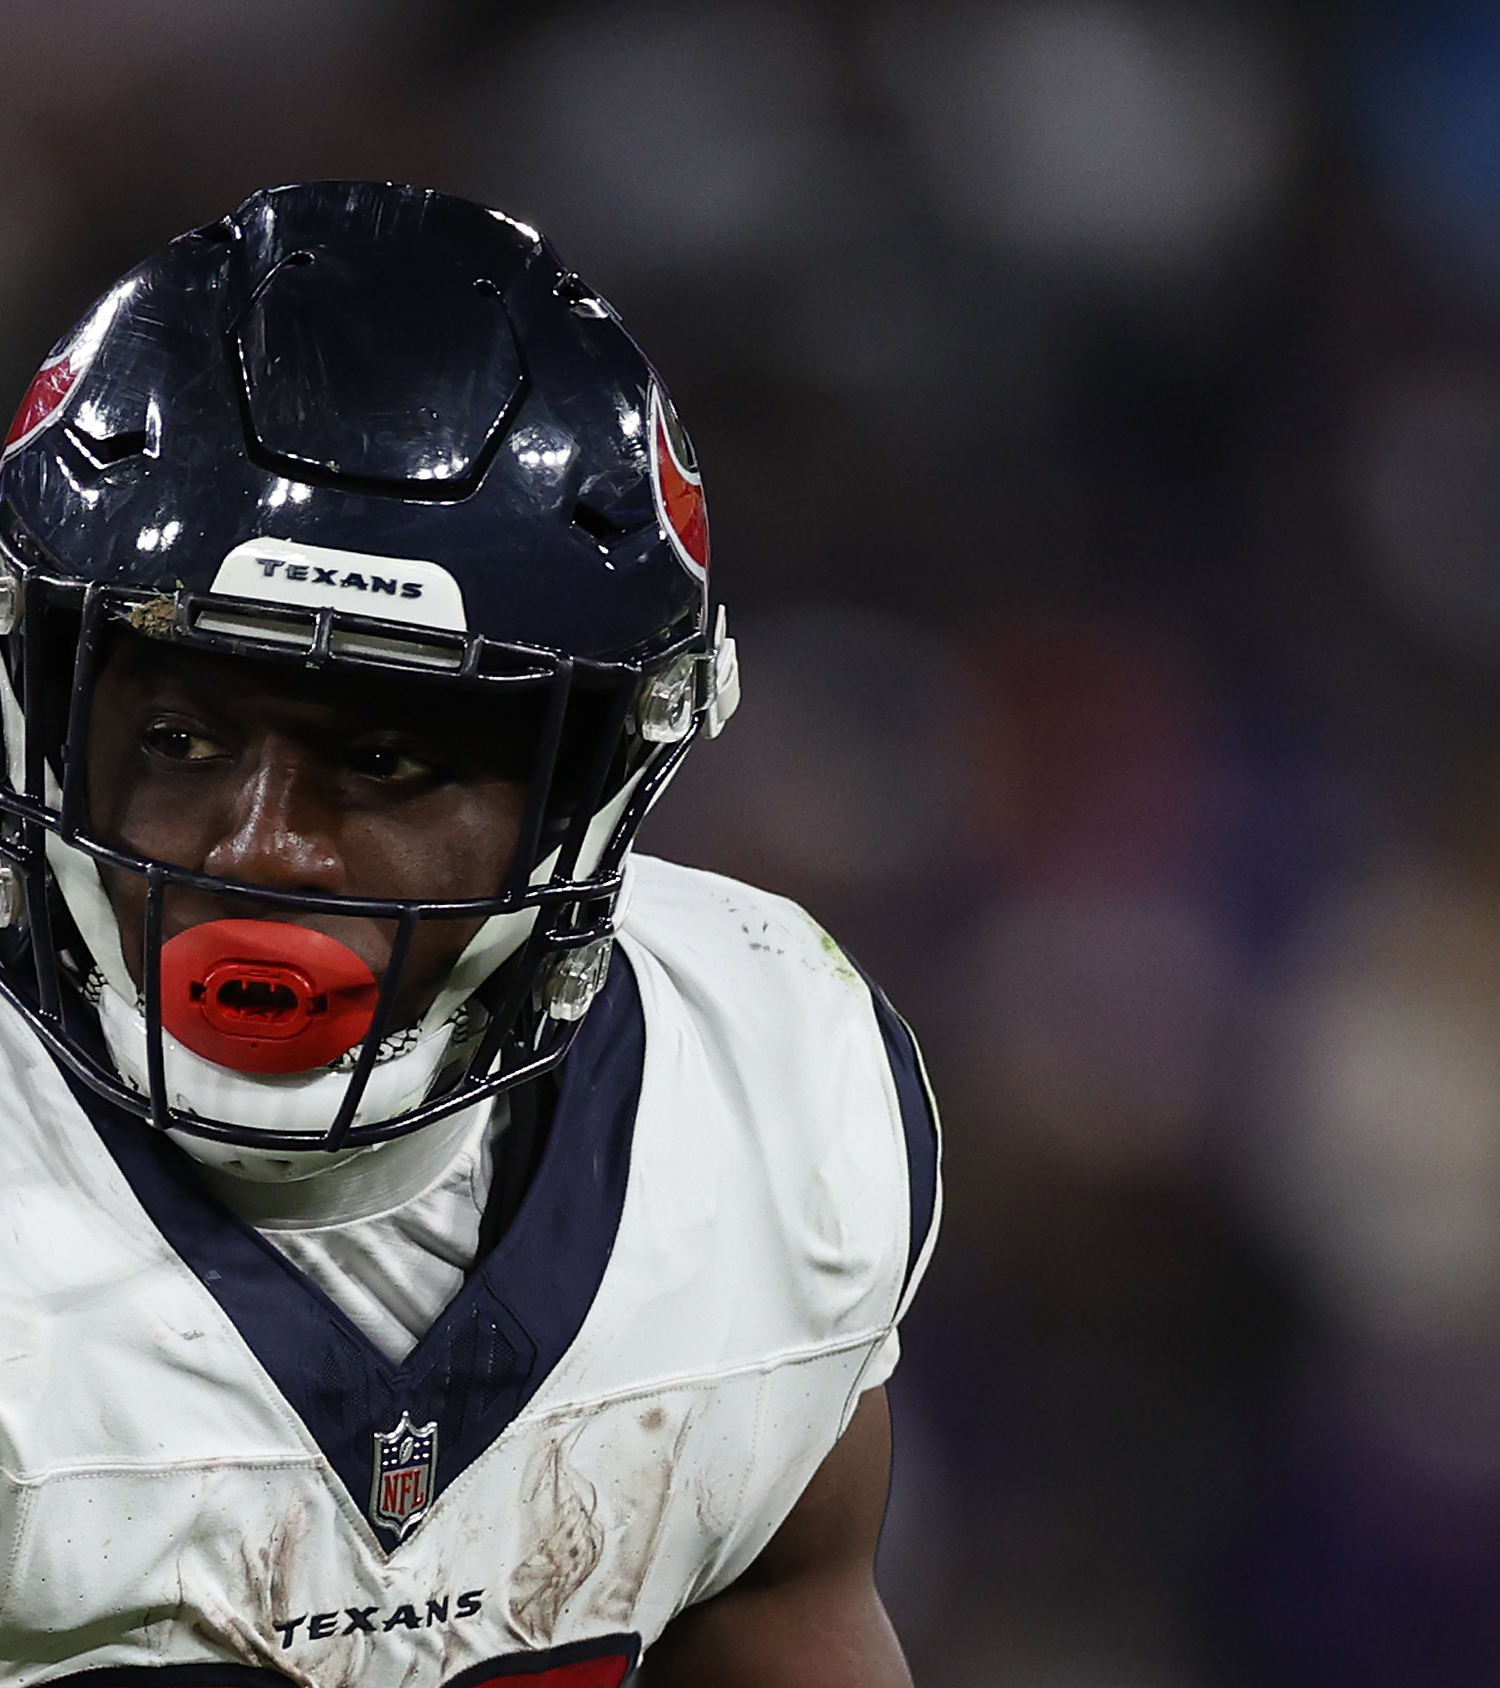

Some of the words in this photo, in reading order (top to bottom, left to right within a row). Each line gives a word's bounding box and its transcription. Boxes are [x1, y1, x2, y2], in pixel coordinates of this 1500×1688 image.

[255, 557, 424, 599] TEXANS
[381, 1468, 425, 1517] NFL
[274, 1589, 486, 1649] TEXANS
